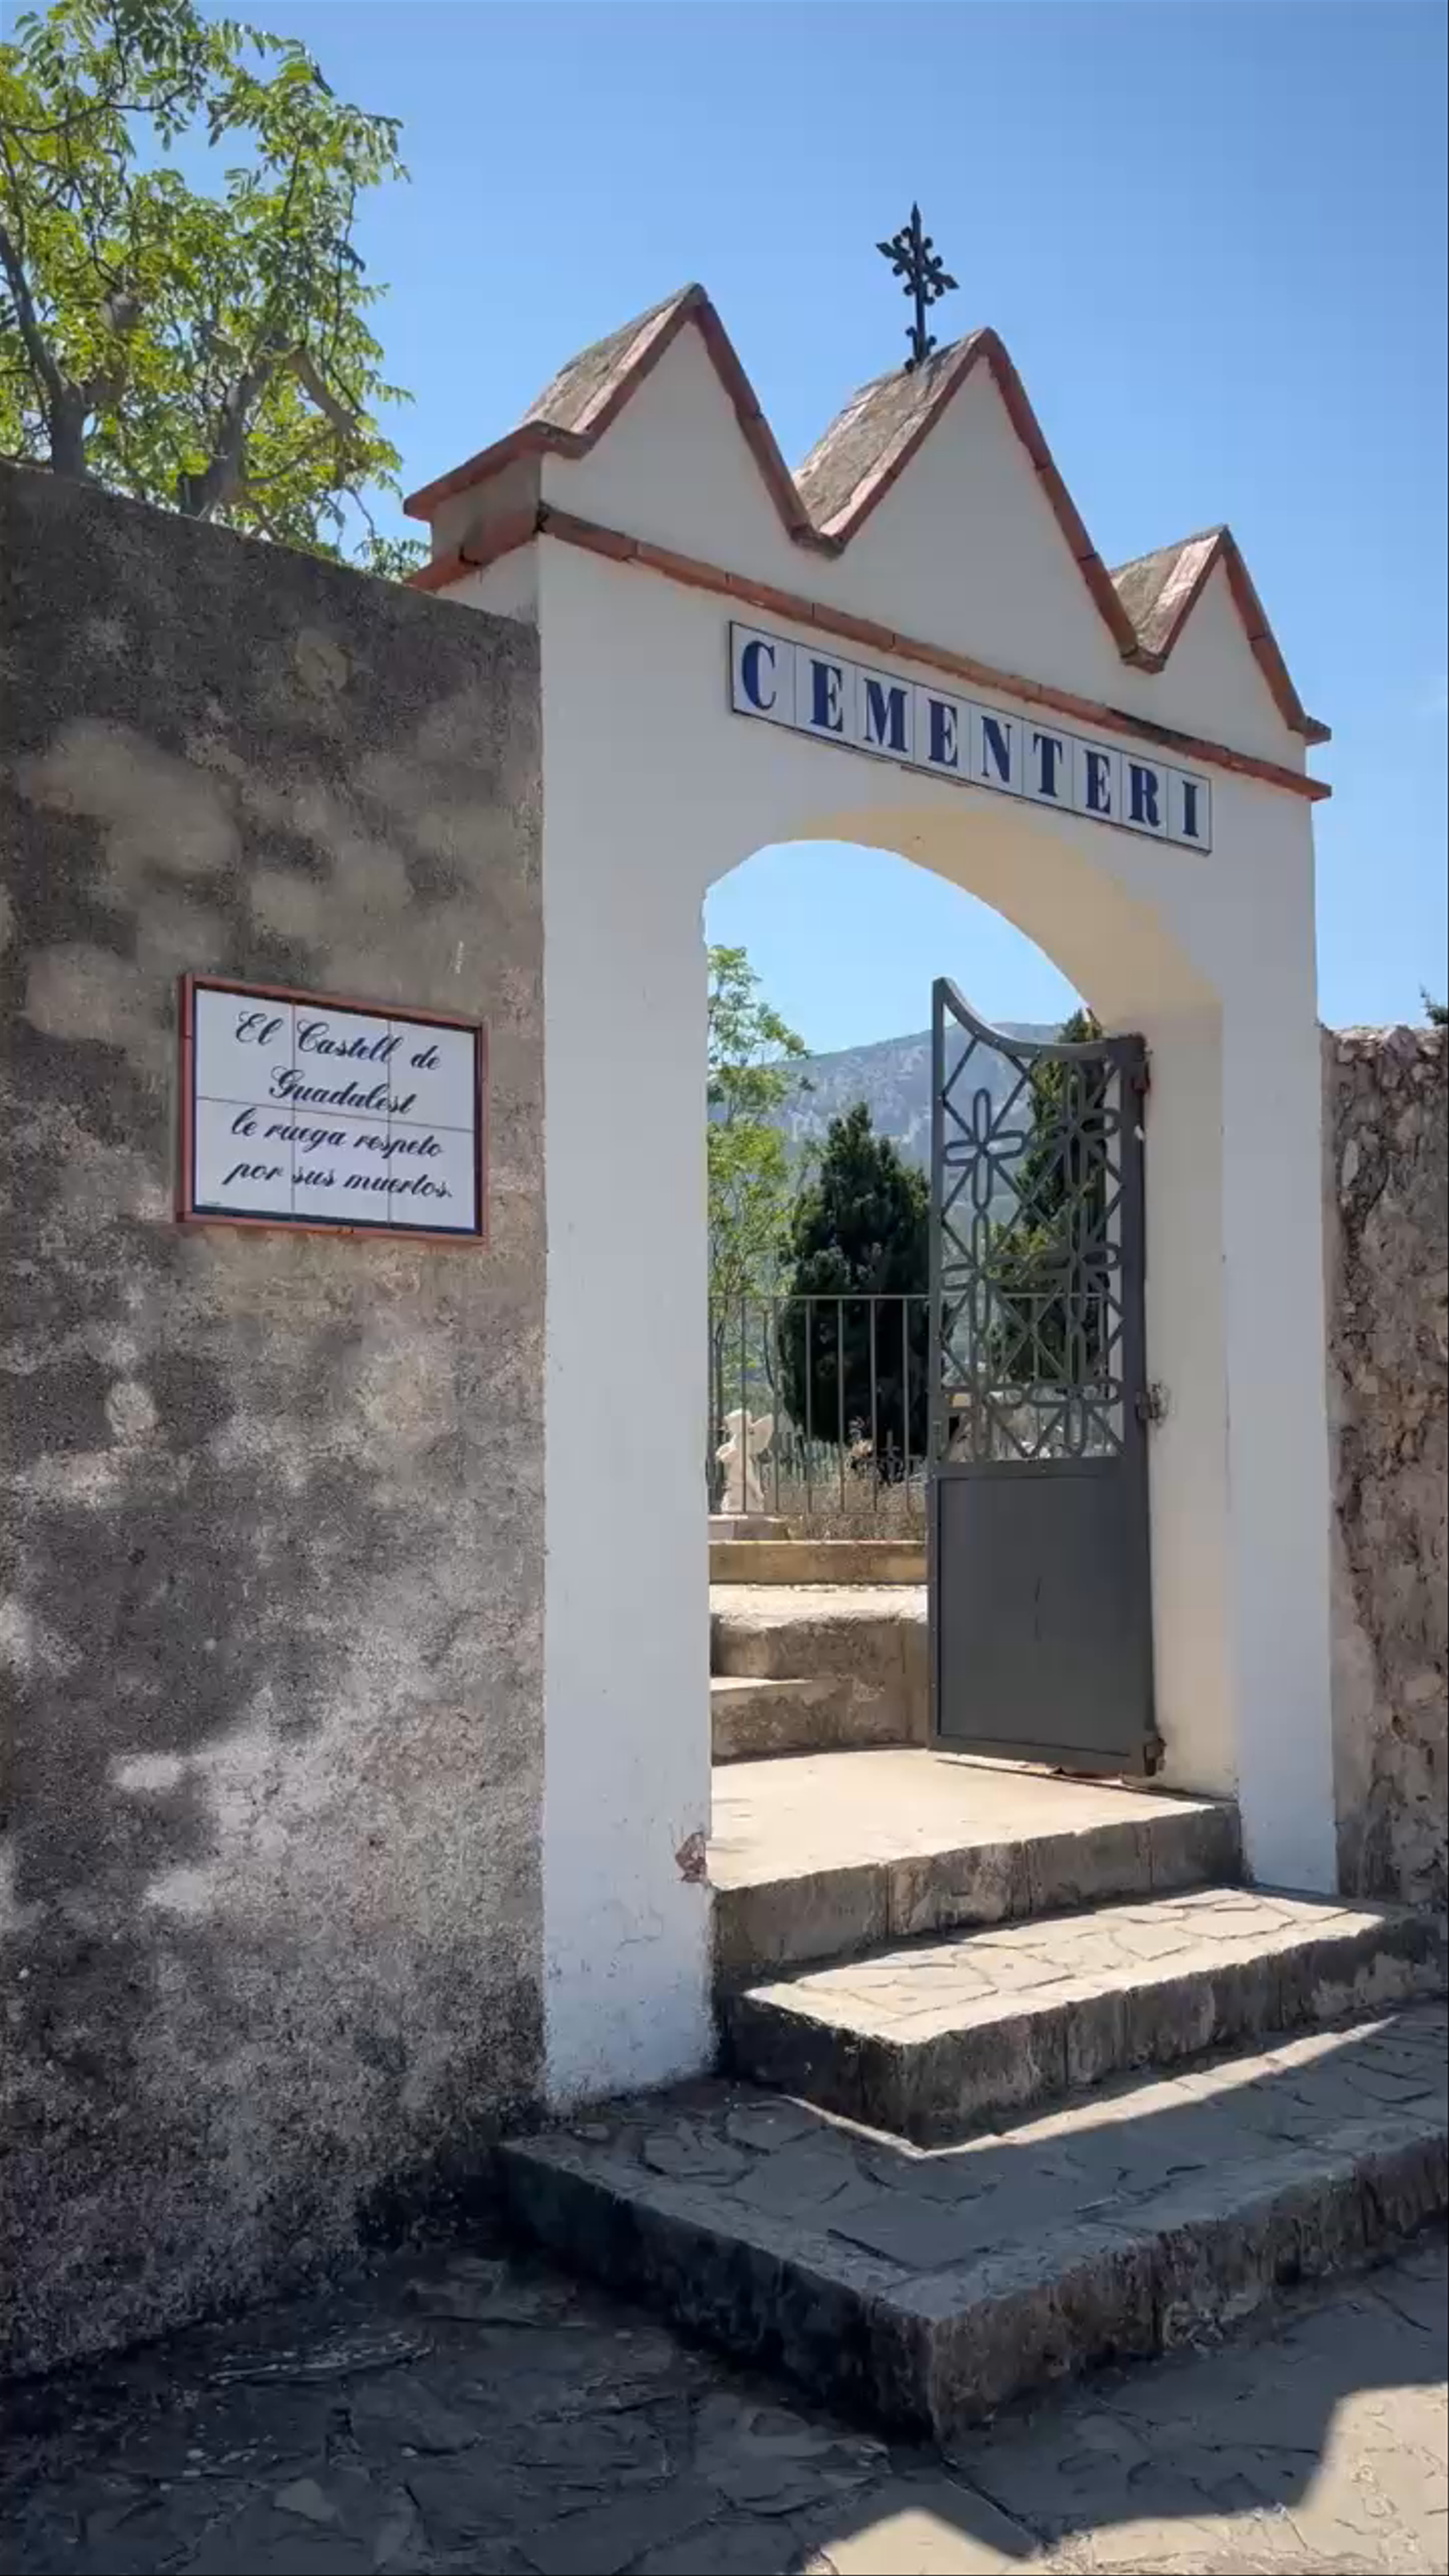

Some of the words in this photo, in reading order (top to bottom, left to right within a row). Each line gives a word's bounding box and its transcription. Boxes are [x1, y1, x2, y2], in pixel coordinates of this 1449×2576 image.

[741, 640, 1199, 838] CEMENTERI
[235, 1011, 283, 1046] El
[297, 1021, 404, 1063] Castell
[411, 1046, 441, 1070] de
[269, 1066, 417, 1115] Guadalest
[231, 1108, 258, 1137] le
[264, 1125, 348, 1152] ruega
[353, 1134, 445, 1159] respeto
[222, 1162, 283, 1185] por
[292, 1166, 335, 1187] sus
[343, 1174, 453, 1198] muertos.
